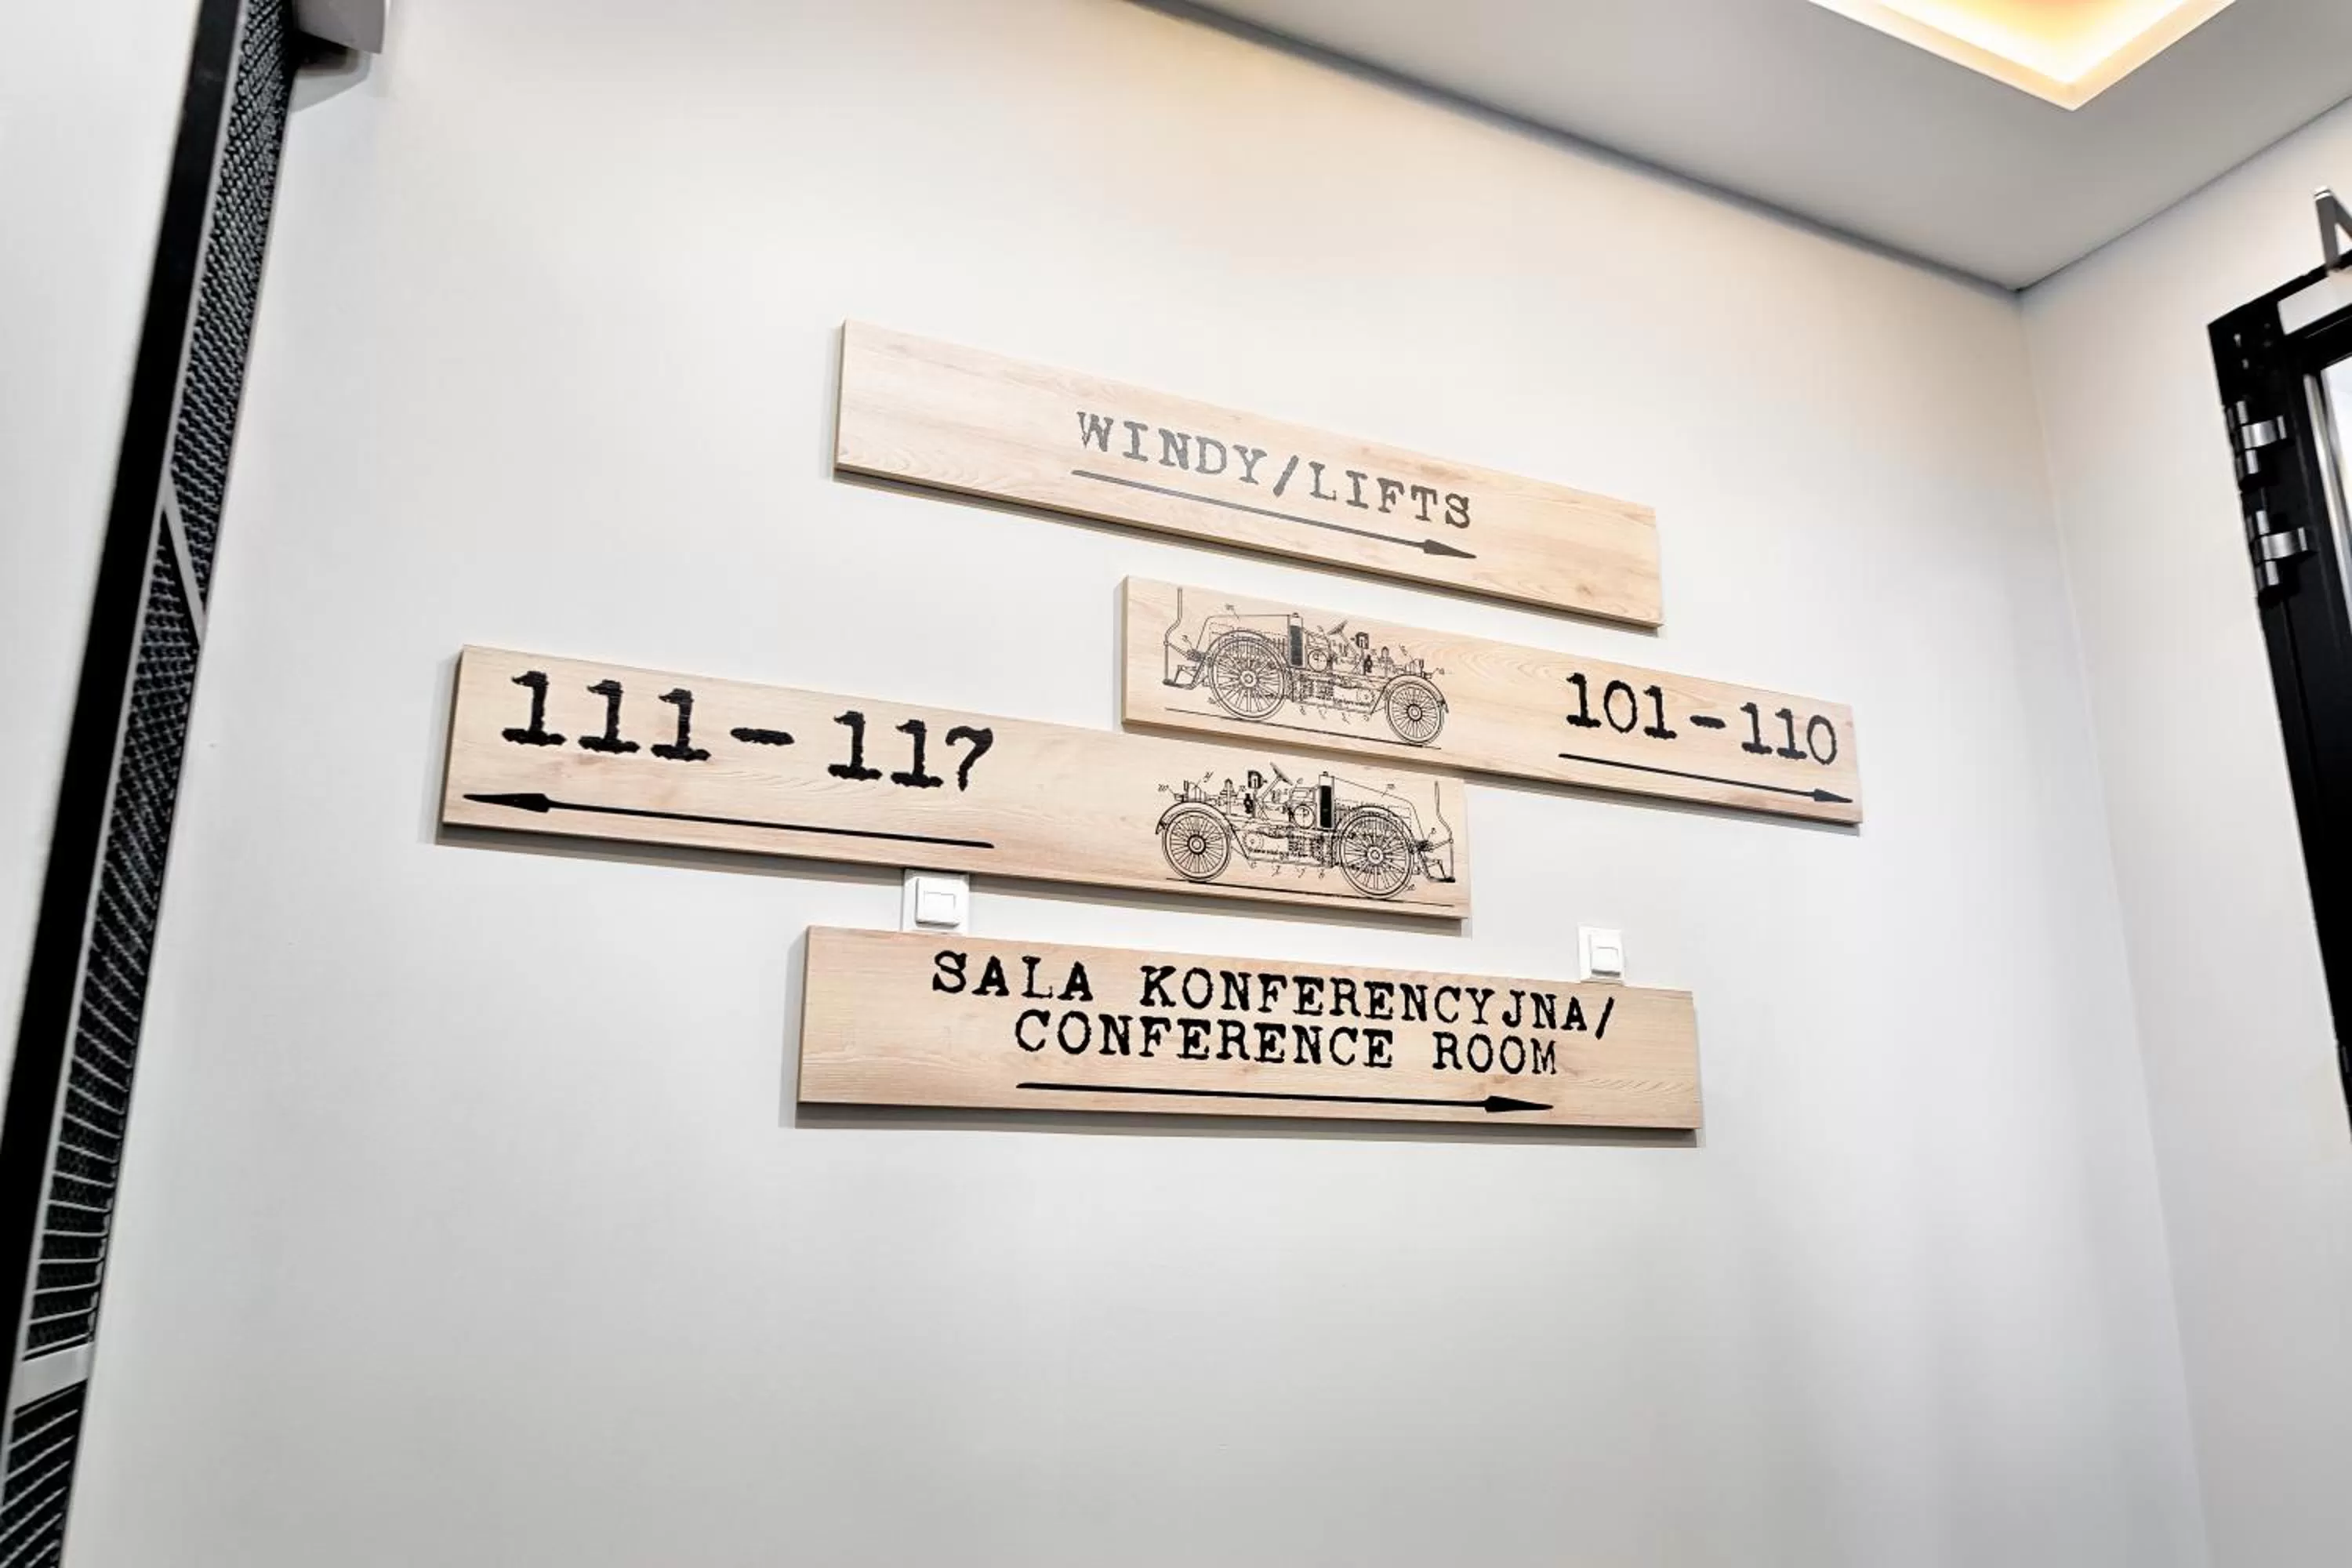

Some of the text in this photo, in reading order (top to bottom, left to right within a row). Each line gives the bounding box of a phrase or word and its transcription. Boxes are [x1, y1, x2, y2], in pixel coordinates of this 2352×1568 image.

[1076, 411, 1471, 529] WINDY/LIFTS
[501, 670, 994, 793] 111-117
[1566, 672, 1838, 766] 101-110
[932, 949, 1615, 1040] SALA KONFERENCYJNA/
[1014, 1008, 1557, 1076] CONFERENCE ROOM
